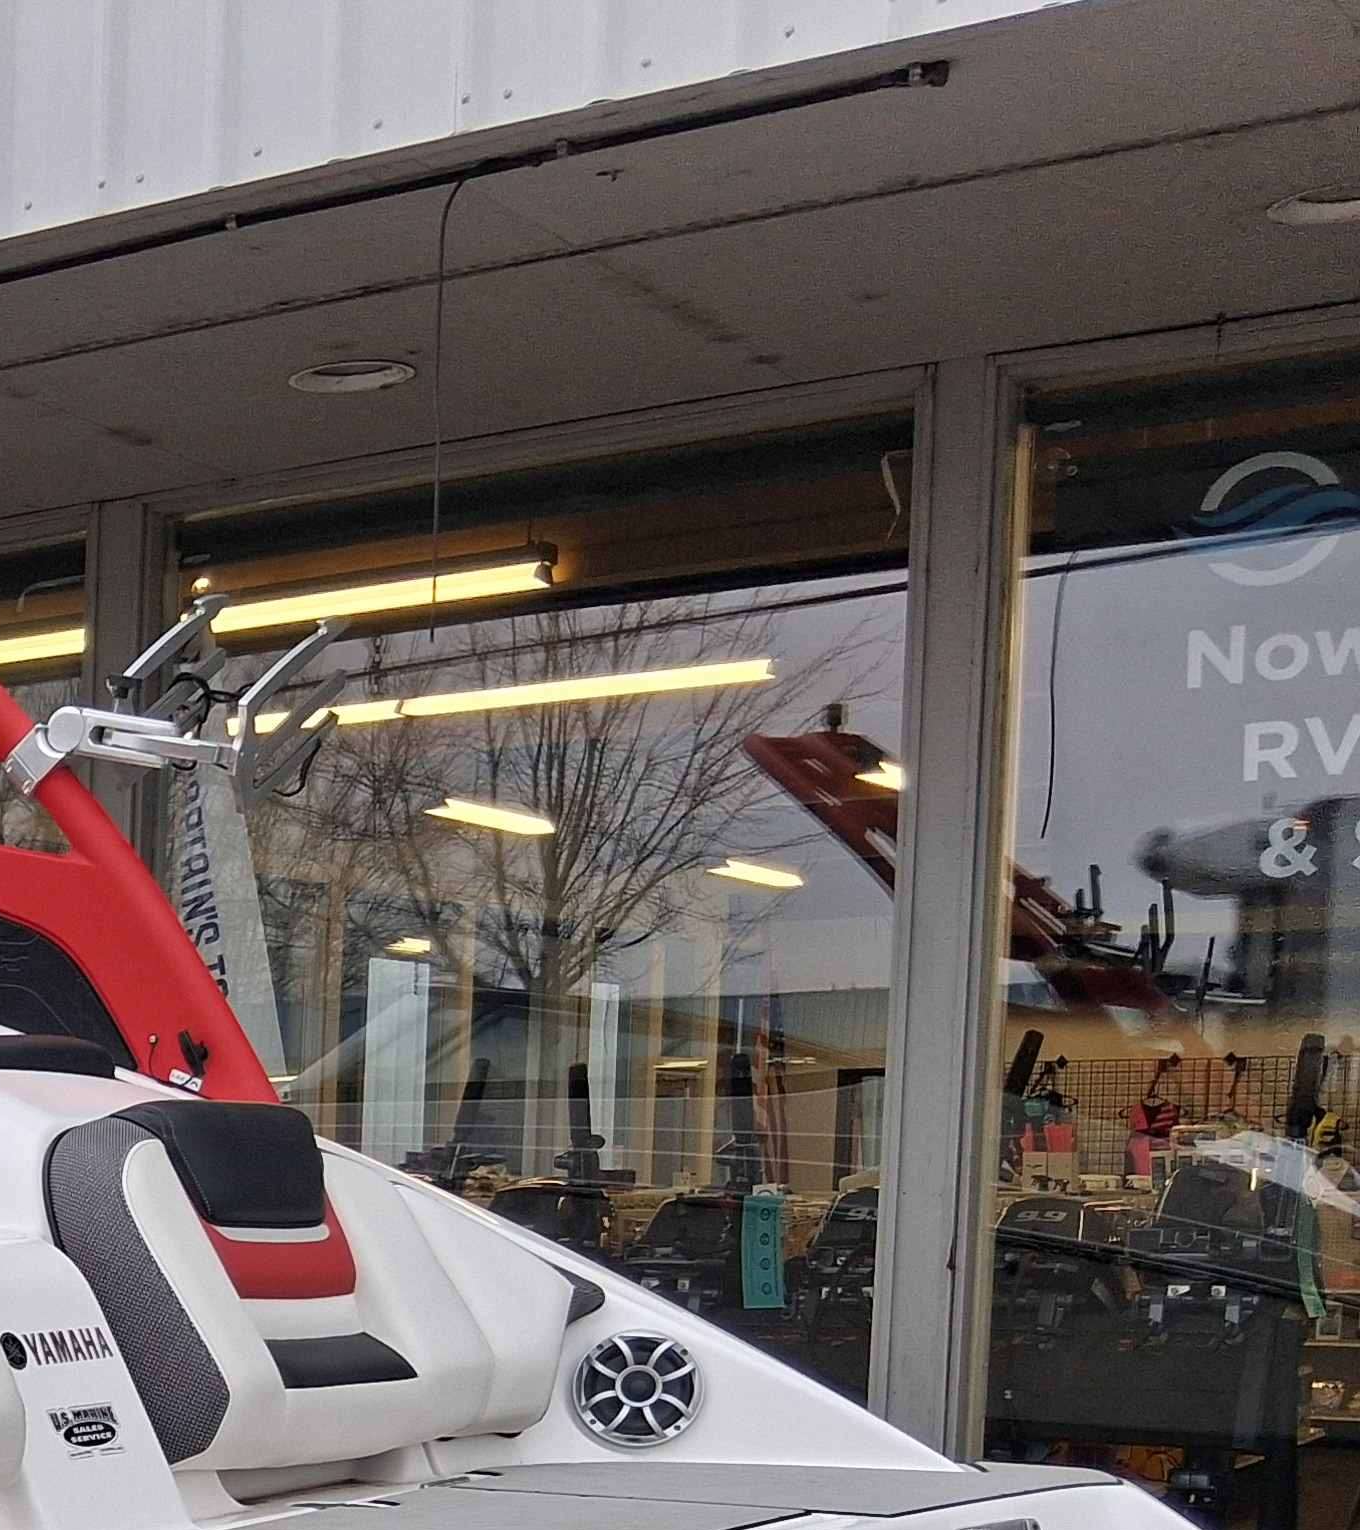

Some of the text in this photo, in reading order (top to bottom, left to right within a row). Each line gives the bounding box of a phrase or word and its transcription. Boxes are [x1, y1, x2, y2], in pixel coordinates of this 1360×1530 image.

[181, 779, 222, 948] APTAIN'S
[1259, 817, 1318, 878] &
[21, 1327, 114, 1366] YAMAHA
[70, 1431, 113, 1443] SERVICE
[72, 1424, 105, 1434] SALES
